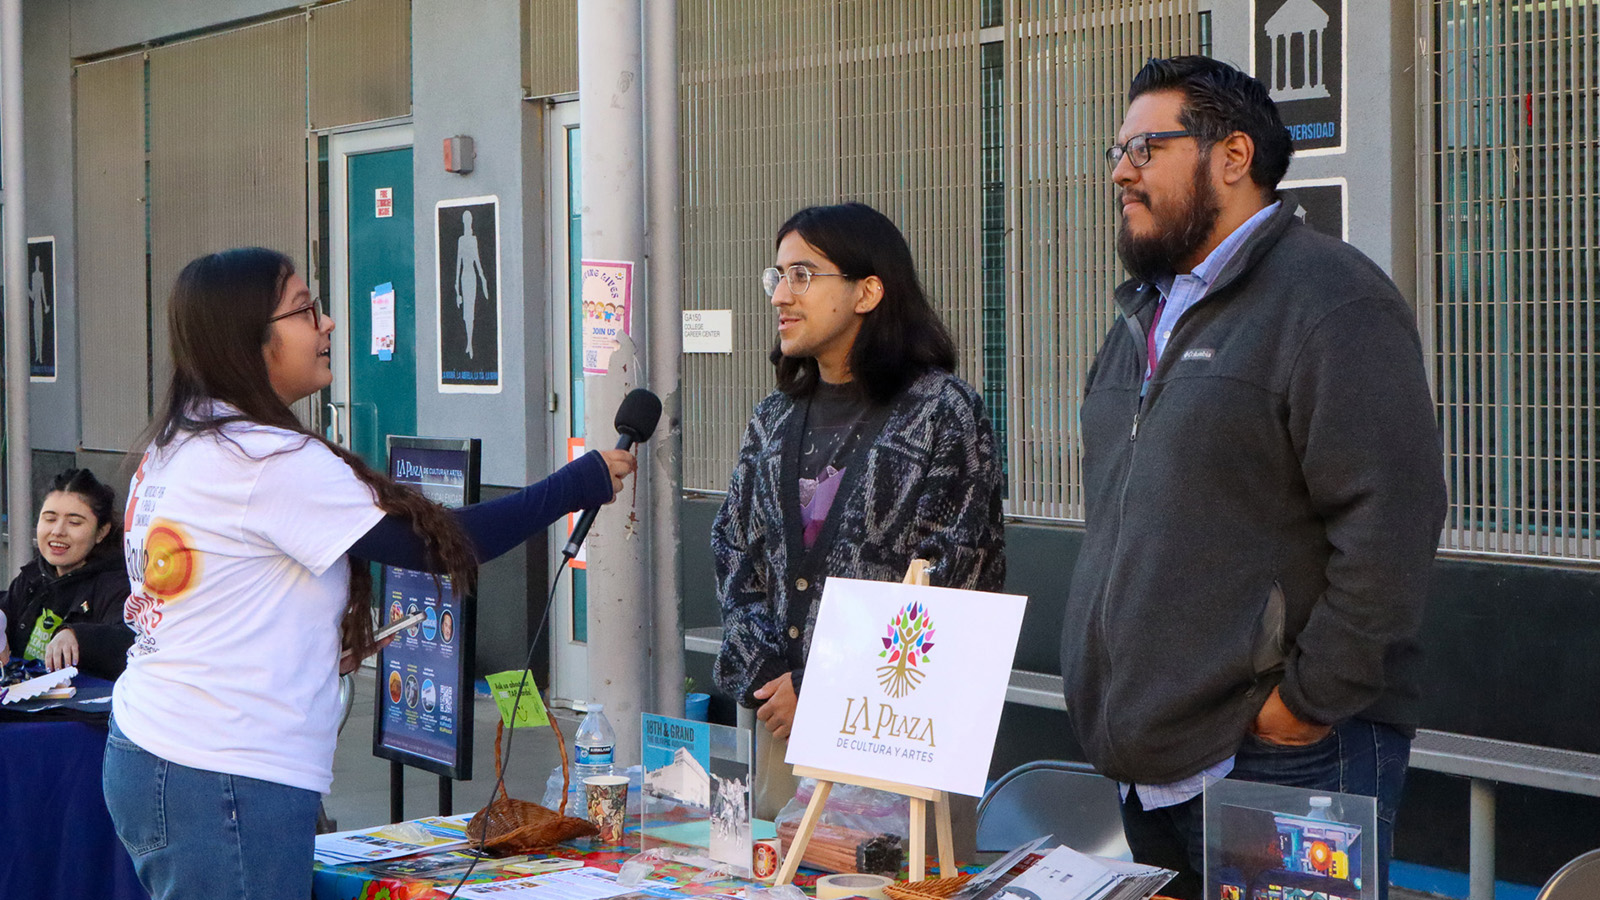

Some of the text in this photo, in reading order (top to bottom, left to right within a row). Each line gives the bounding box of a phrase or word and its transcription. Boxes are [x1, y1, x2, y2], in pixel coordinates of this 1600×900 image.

[1285, 121, 1335, 141] VERSIDAD
[684, 313, 701, 322] GA150
[684, 323, 704, 331] COLLEGE
[592, 327, 616, 336] JOIN US
[684, 330, 721, 338] CAREER CENTER
[396, 459, 405, 478] LA
[405, 461, 424, 479] PLAZA
[429, 468, 446, 476] CULTURA
[449, 469, 463, 477] ARTES
[646, 720, 695, 742] 18TH & GRAND
[839, 696, 936, 748] LA PLAZA
[836, 737, 934, 763] DE CULTURA Y ARTES
